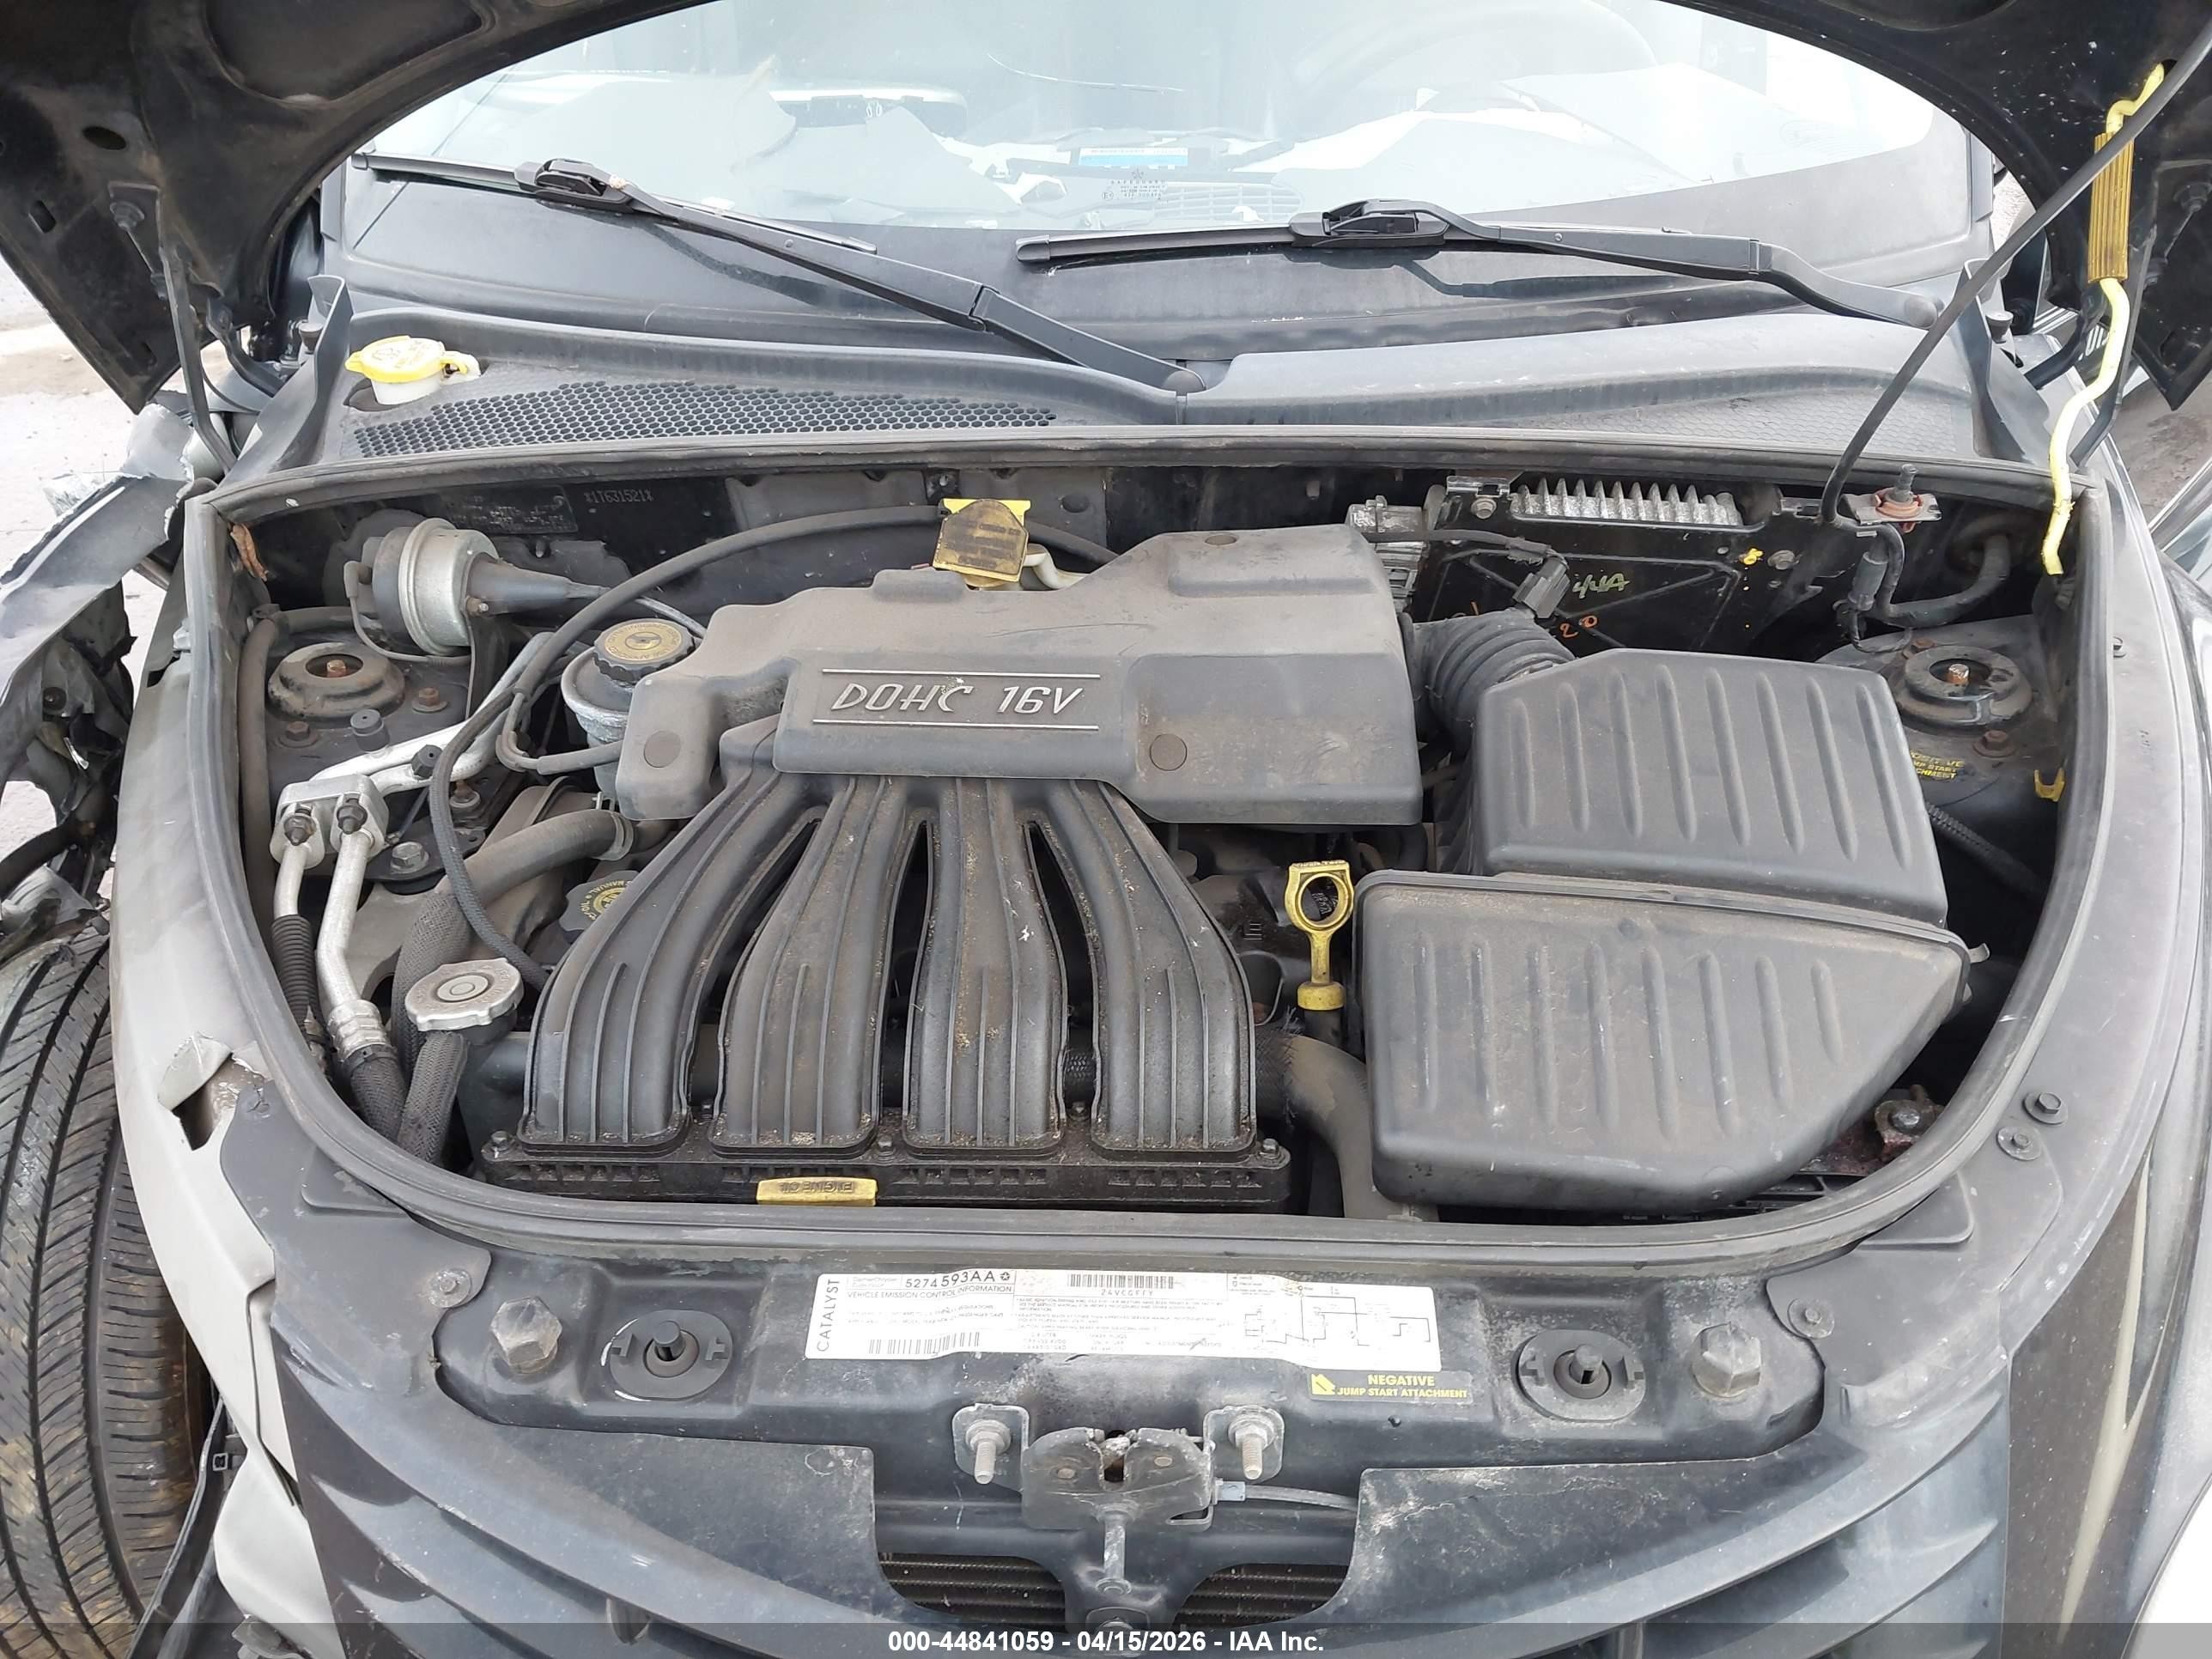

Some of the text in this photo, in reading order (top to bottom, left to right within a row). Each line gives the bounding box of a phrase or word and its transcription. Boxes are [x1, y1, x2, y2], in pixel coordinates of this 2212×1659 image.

[830, 683, 1084, 714] DOHC 16V
[920, 1290, 956, 1298] CONTROL
[817, 1279, 840, 1352] CATALYST
[1368, 1374, 1435, 1387] NEGATIVE
[1336, 1387, 1468, 1398] JUMP START ATTACHMENT
